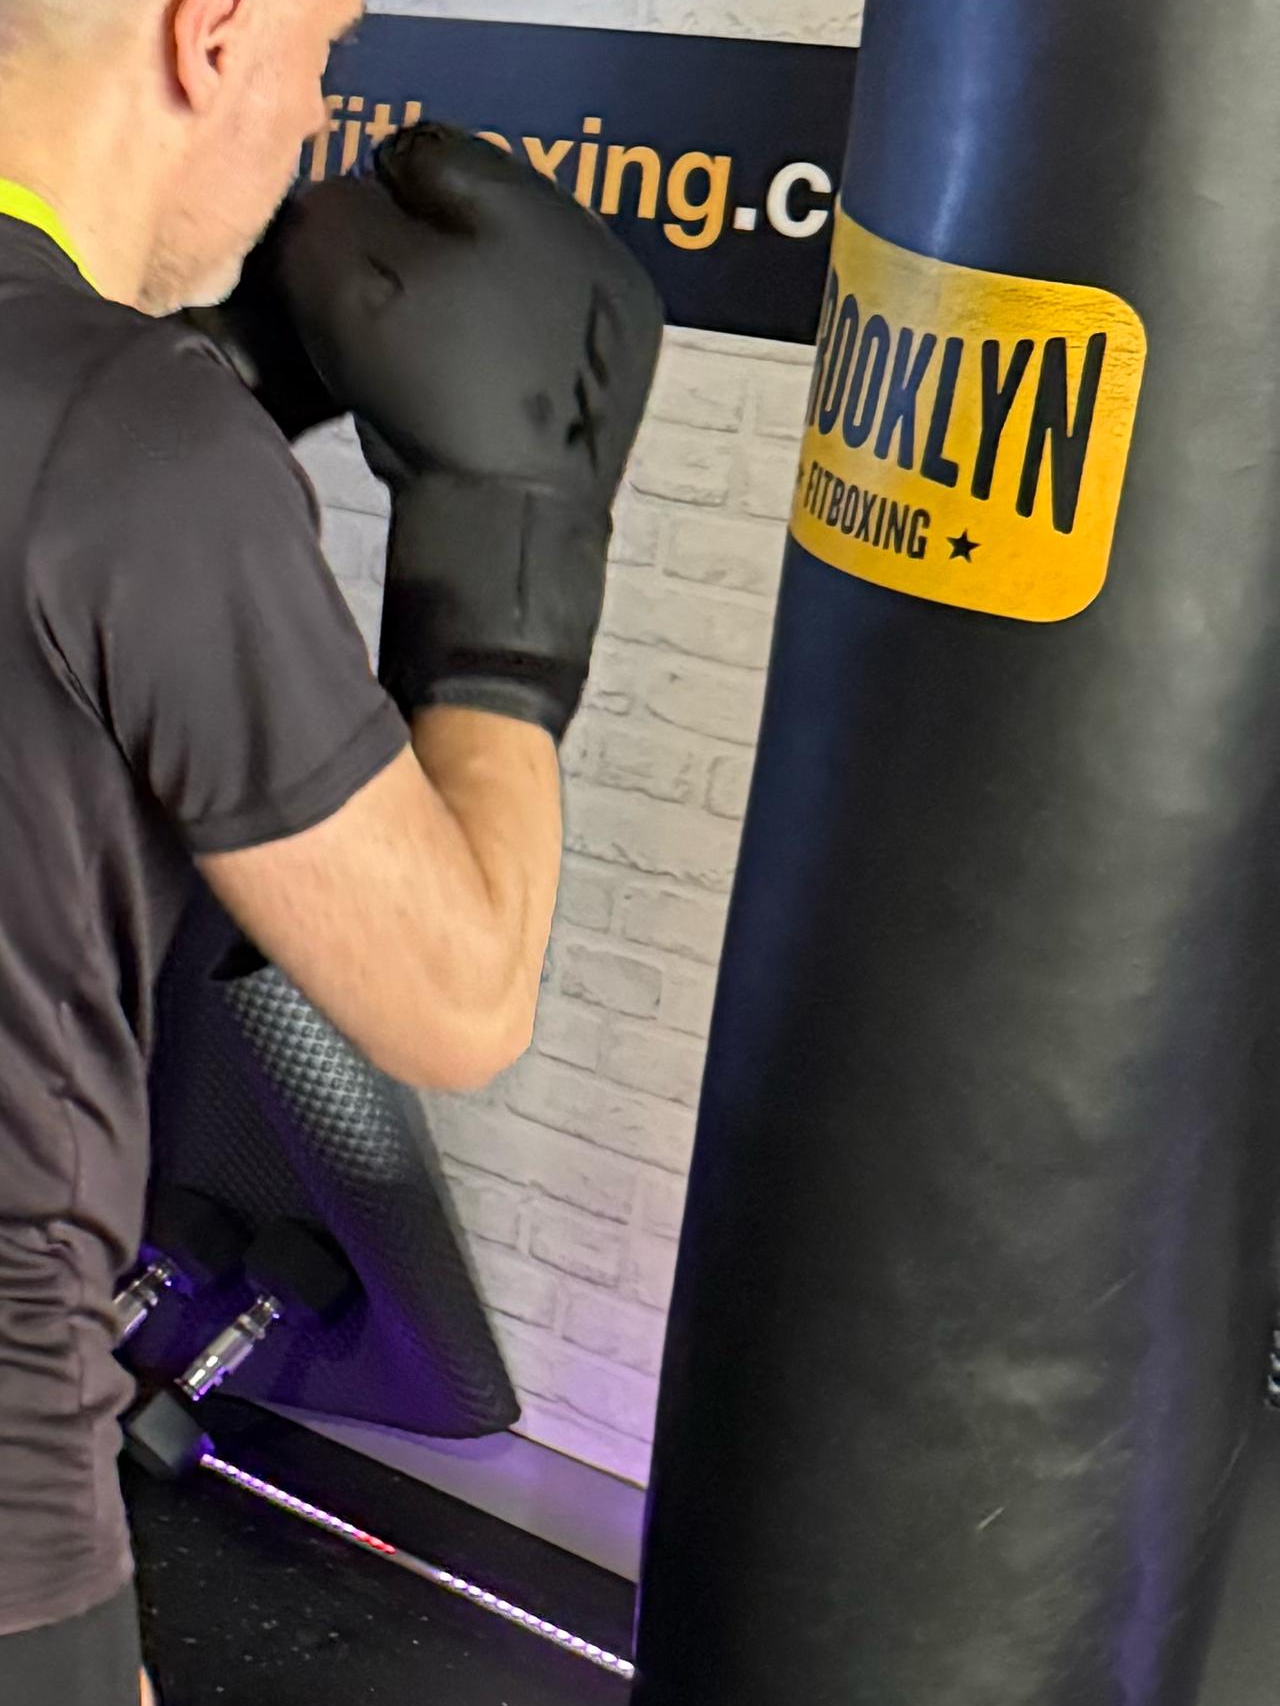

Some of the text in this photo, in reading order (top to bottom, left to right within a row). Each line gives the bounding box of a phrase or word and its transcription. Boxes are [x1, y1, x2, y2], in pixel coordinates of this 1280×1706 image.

[310, 94, 832, 250] fitxing.c
[806, 268, 1107, 535] ROOKLYN
[803, 461, 931, 560] FITBOXING
